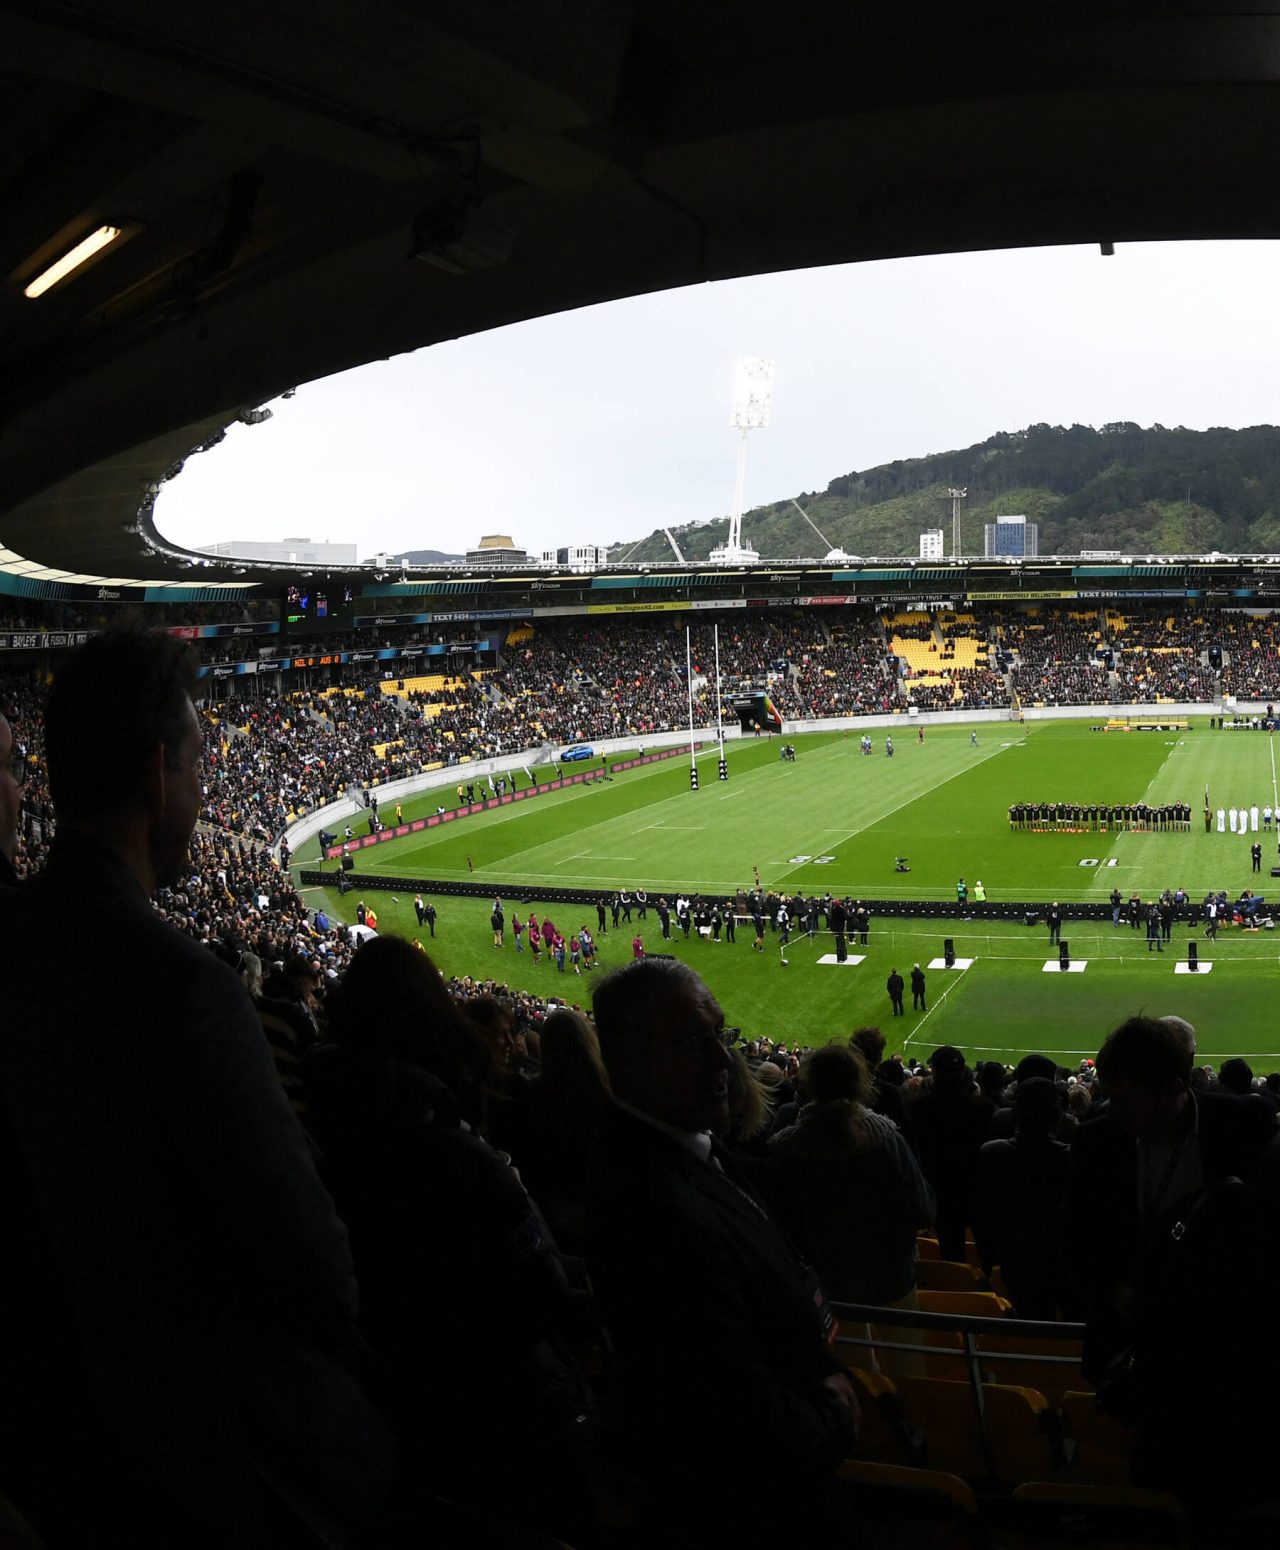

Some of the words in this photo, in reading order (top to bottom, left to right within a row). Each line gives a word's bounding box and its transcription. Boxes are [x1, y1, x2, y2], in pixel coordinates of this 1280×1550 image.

[13, 635, 36, 647] BAYLEYS
[294, 658, 307, 668] NZL
[308, 658, 314, 666] 0
[320, 656, 332, 665] AUS
[334, 655, 339, 663] 0
